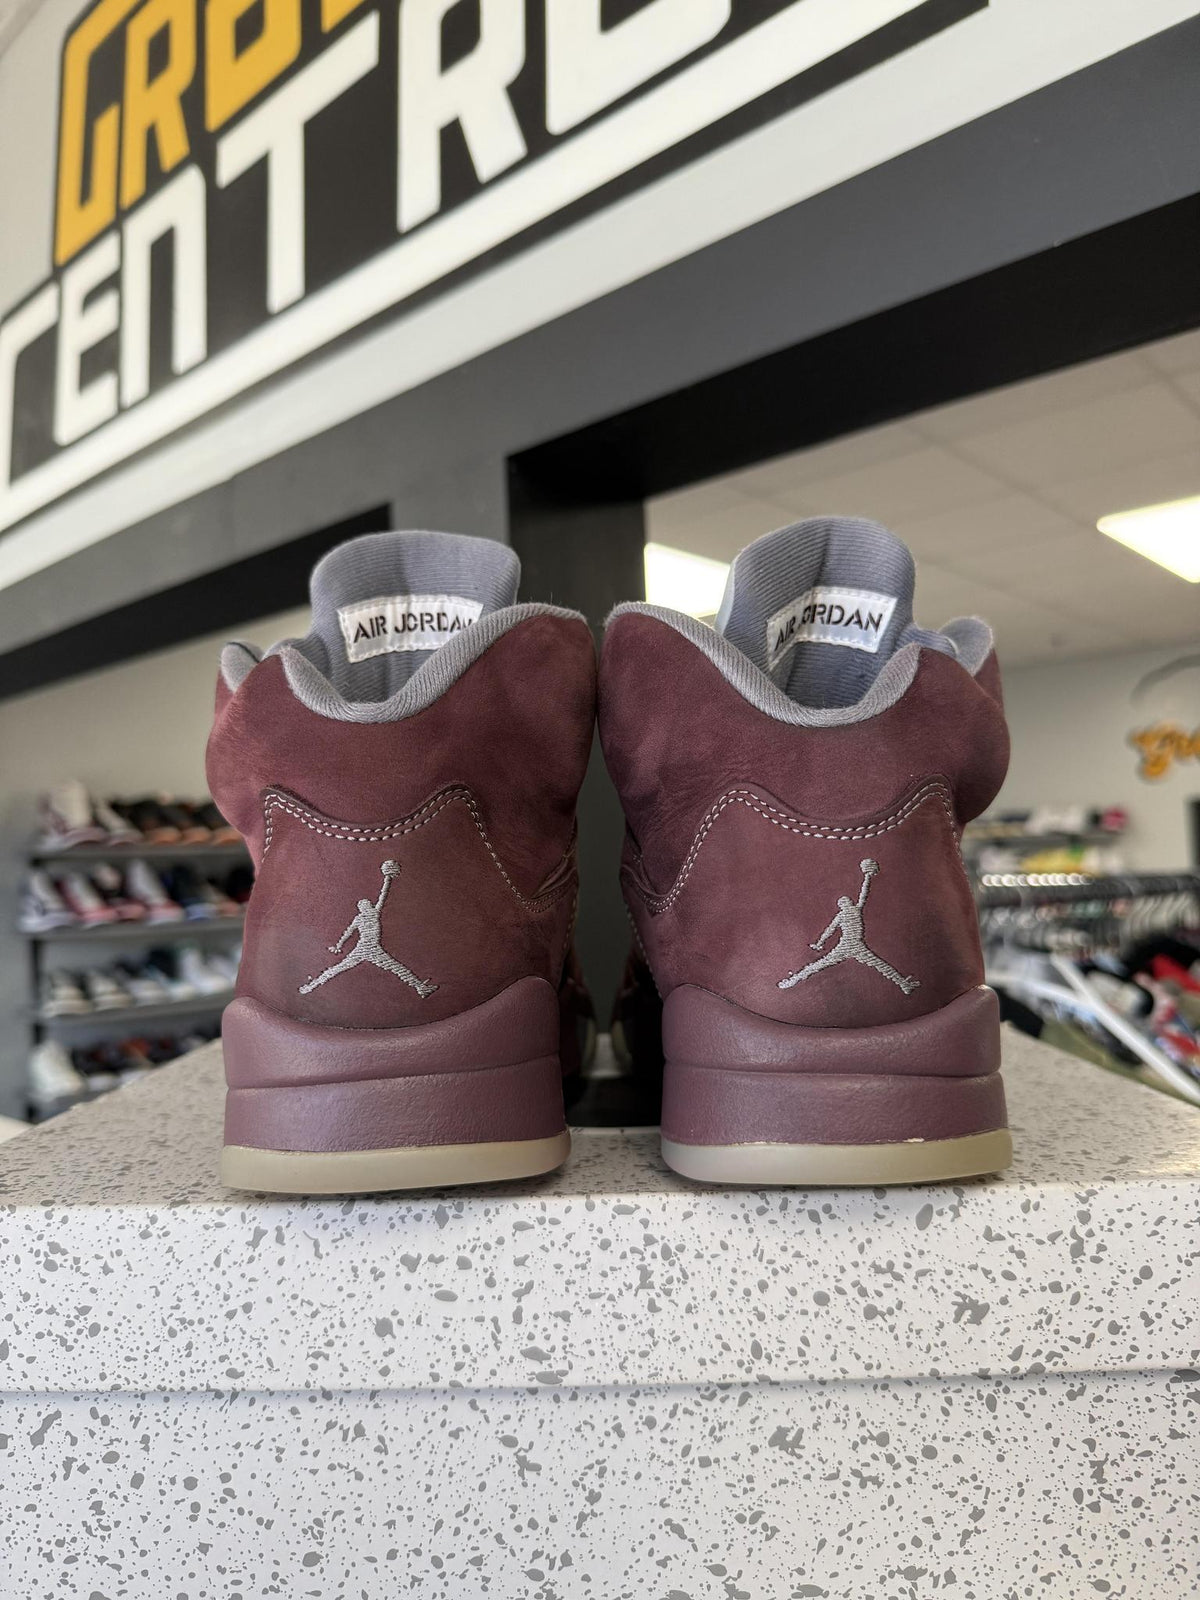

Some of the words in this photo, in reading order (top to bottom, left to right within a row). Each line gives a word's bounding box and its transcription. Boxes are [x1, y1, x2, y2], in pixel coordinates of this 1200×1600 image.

[353, 615, 388, 643] AIR
[774, 615, 797, 652] AIR
[798, 603, 883, 633] ORDAN
